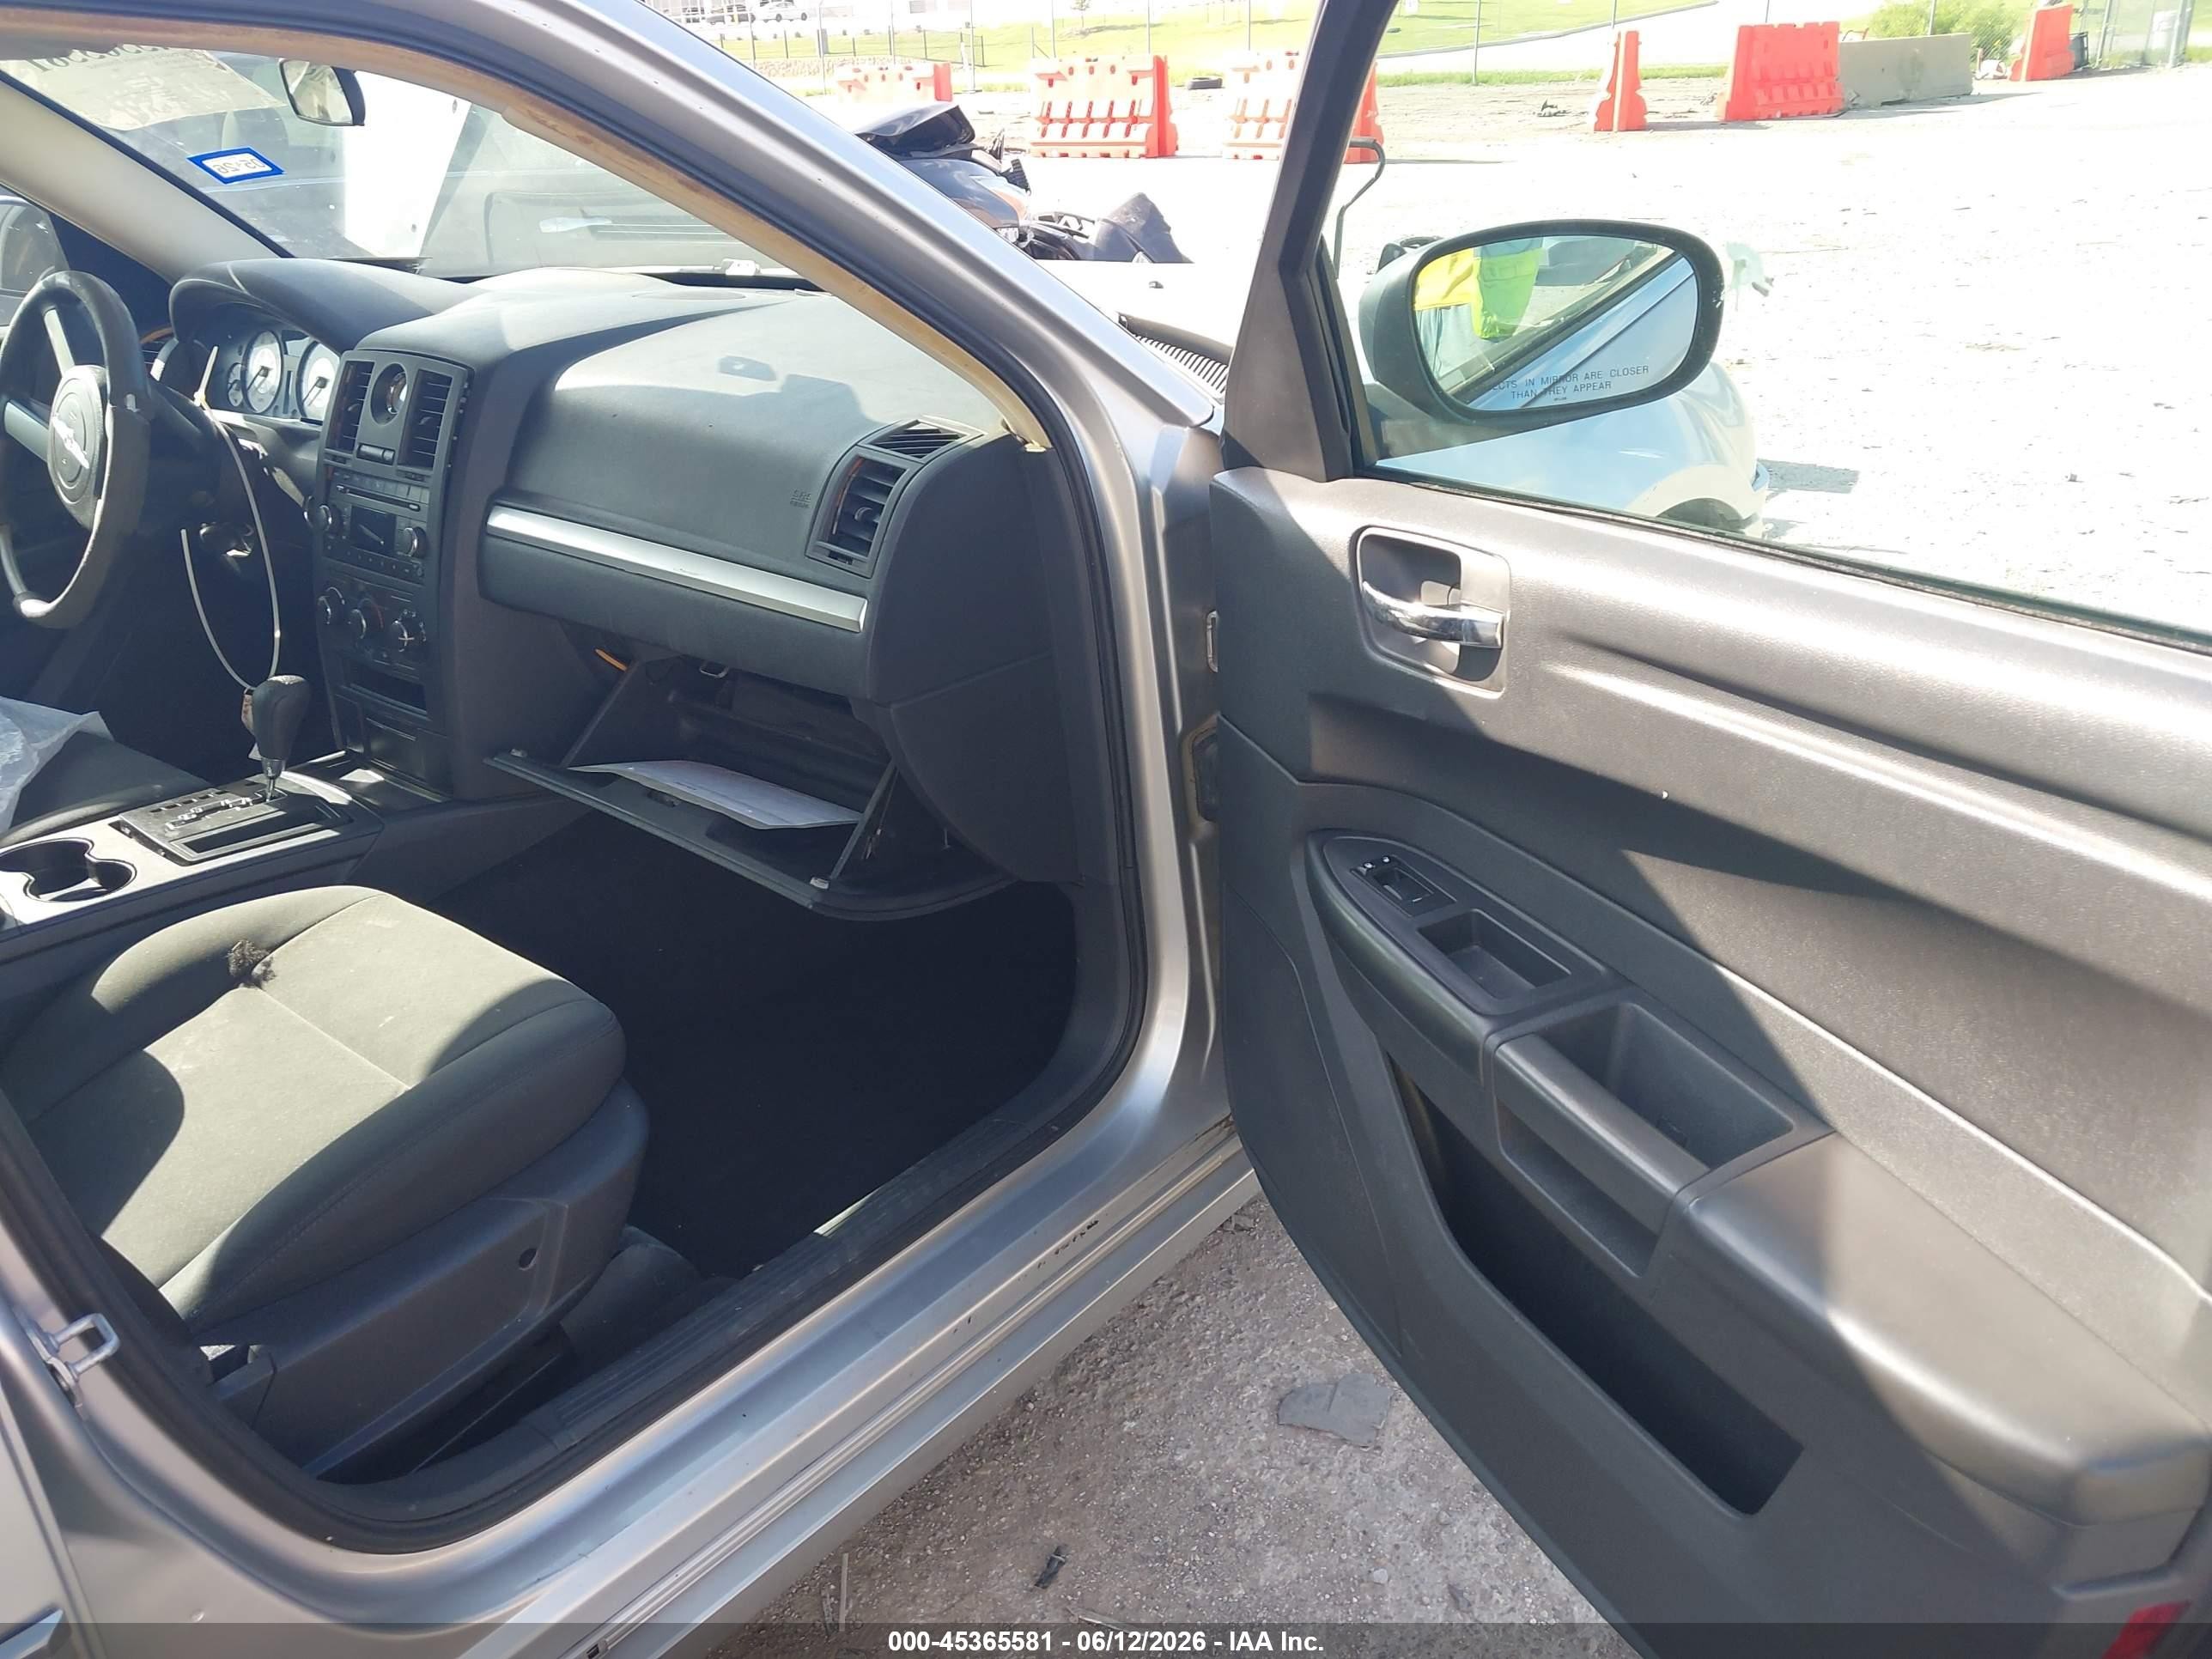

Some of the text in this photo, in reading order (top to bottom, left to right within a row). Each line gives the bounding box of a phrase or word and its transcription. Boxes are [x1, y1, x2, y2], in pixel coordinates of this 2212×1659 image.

[1525, 377, 1535, 387] IN
[1583, 371, 1603, 380] ARE
[1609, 365, 1650, 378] CLOSER
[1511, 388, 1537, 399] THAN
[1573, 380, 1612, 393] APPEAR
